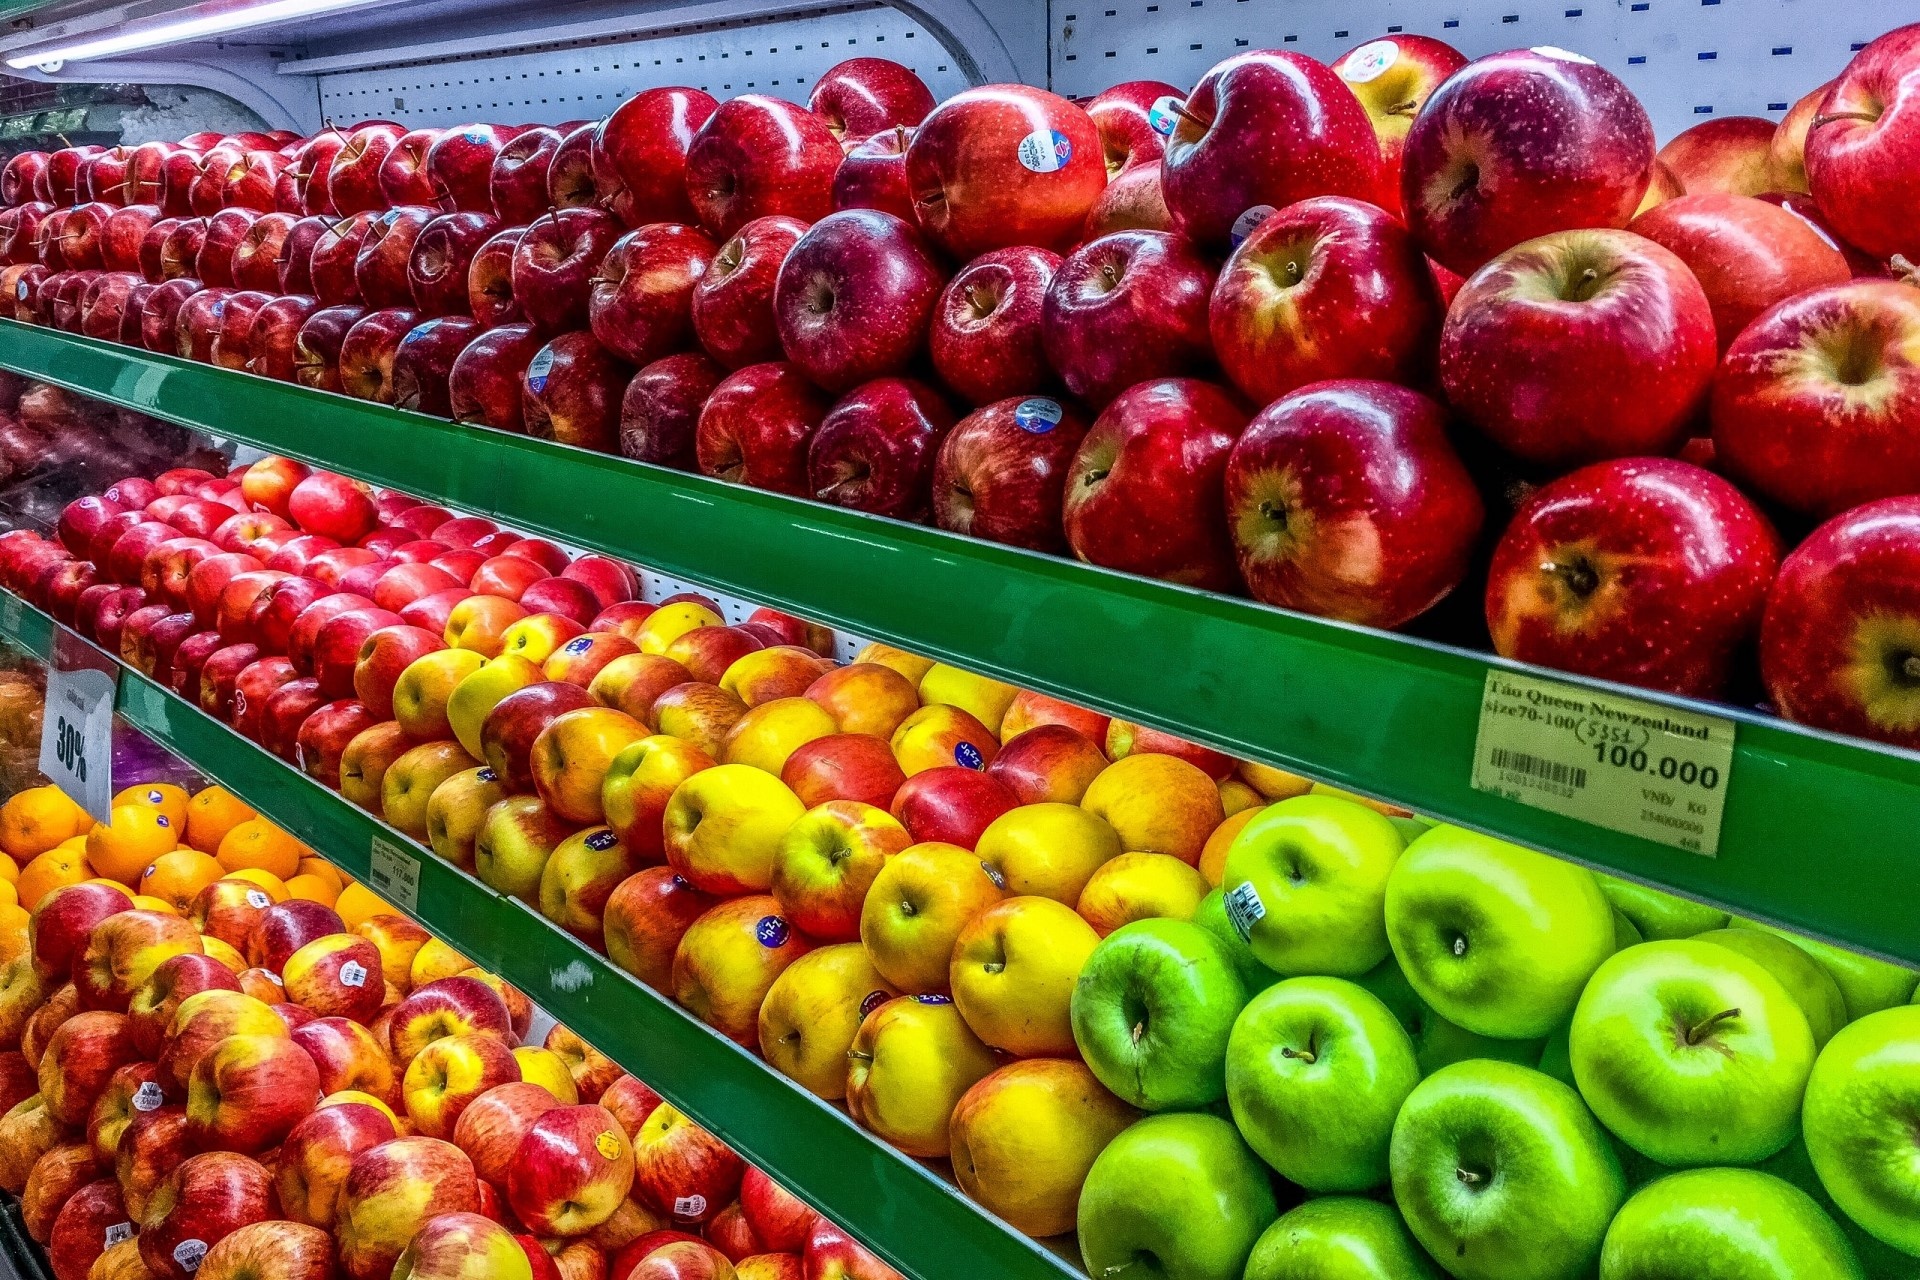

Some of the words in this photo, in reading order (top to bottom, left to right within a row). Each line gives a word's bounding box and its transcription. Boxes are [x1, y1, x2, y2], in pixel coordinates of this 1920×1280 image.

[566, 638, 587, 653] JAZZ
[1526, 689, 1584, 713] Queen
[56, 715, 87, 783] 30%
[961, 743, 980, 766] JAZZ
[1592, 741, 1719, 789] 100.000
[759, 918, 782, 941] JAZZ
